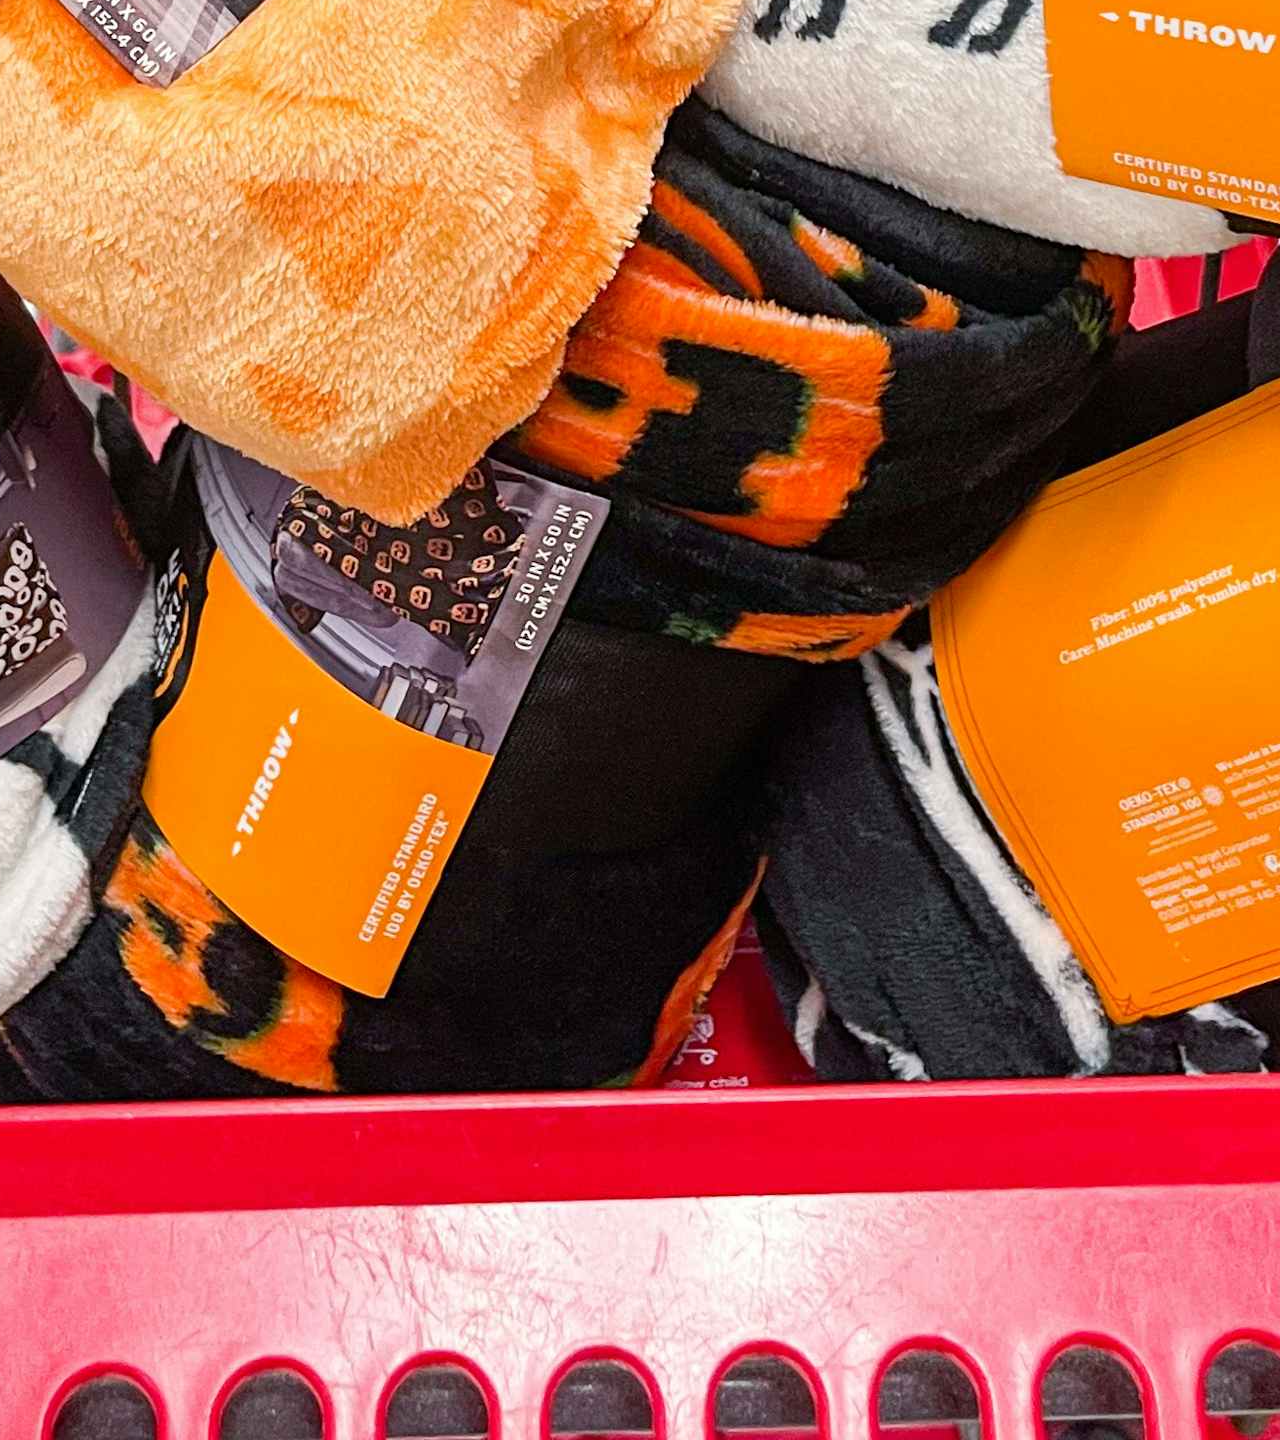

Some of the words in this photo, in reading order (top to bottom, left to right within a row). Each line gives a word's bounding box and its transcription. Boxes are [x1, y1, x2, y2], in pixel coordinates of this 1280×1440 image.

[90, 4, 131, 48] 152.4
[129, 46, 161, 78] CM)
[119, 2, 136, 21] X
[132, 17, 157, 43] 60
[154, 41, 177, 63] IN
[1128, 10, 1276, 54] THROW
[1113, 151, 1202, 181] CERTIFIED
[1130, 170, 1161, 188] 100
[1167, 178, 1189, 194] BY
[553, 504, 572, 524] IN
[569, 510, 593, 541] CM)
[542, 525, 562, 547] 60
[526, 561, 545, 581] IN
[535, 549, 552, 562] X
[548, 541, 577, 581] 152.4
[515, 583, 535, 605] 50
[541, 582, 559, 595] X
[1132, 589, 1169, 615] 100%
[1169, 564, 1233, 602] polyester
[531, 596, 552, 619] CM
[1059, 643, 1096, 664] Care:
[1095, 617, 1154, 651] Machine
[1155, 601, 1195, 625] wash.
[1195, 578, 1251, 609] Tumble
[1251, 567, 1280, 585] dry.
[514, 620, 539, 651] (127
[236, 725, 293, 836] THROW
[1121, 804, 1180, 834] STANDARD
[1182, 796, 1203, 810] 100
[358, 871, 401, 943] CERTIFIED
[393, 793, 438, 870] STANDARD
[384, 912, 406, 939] 100
[396, 890, 416, 910] BY
